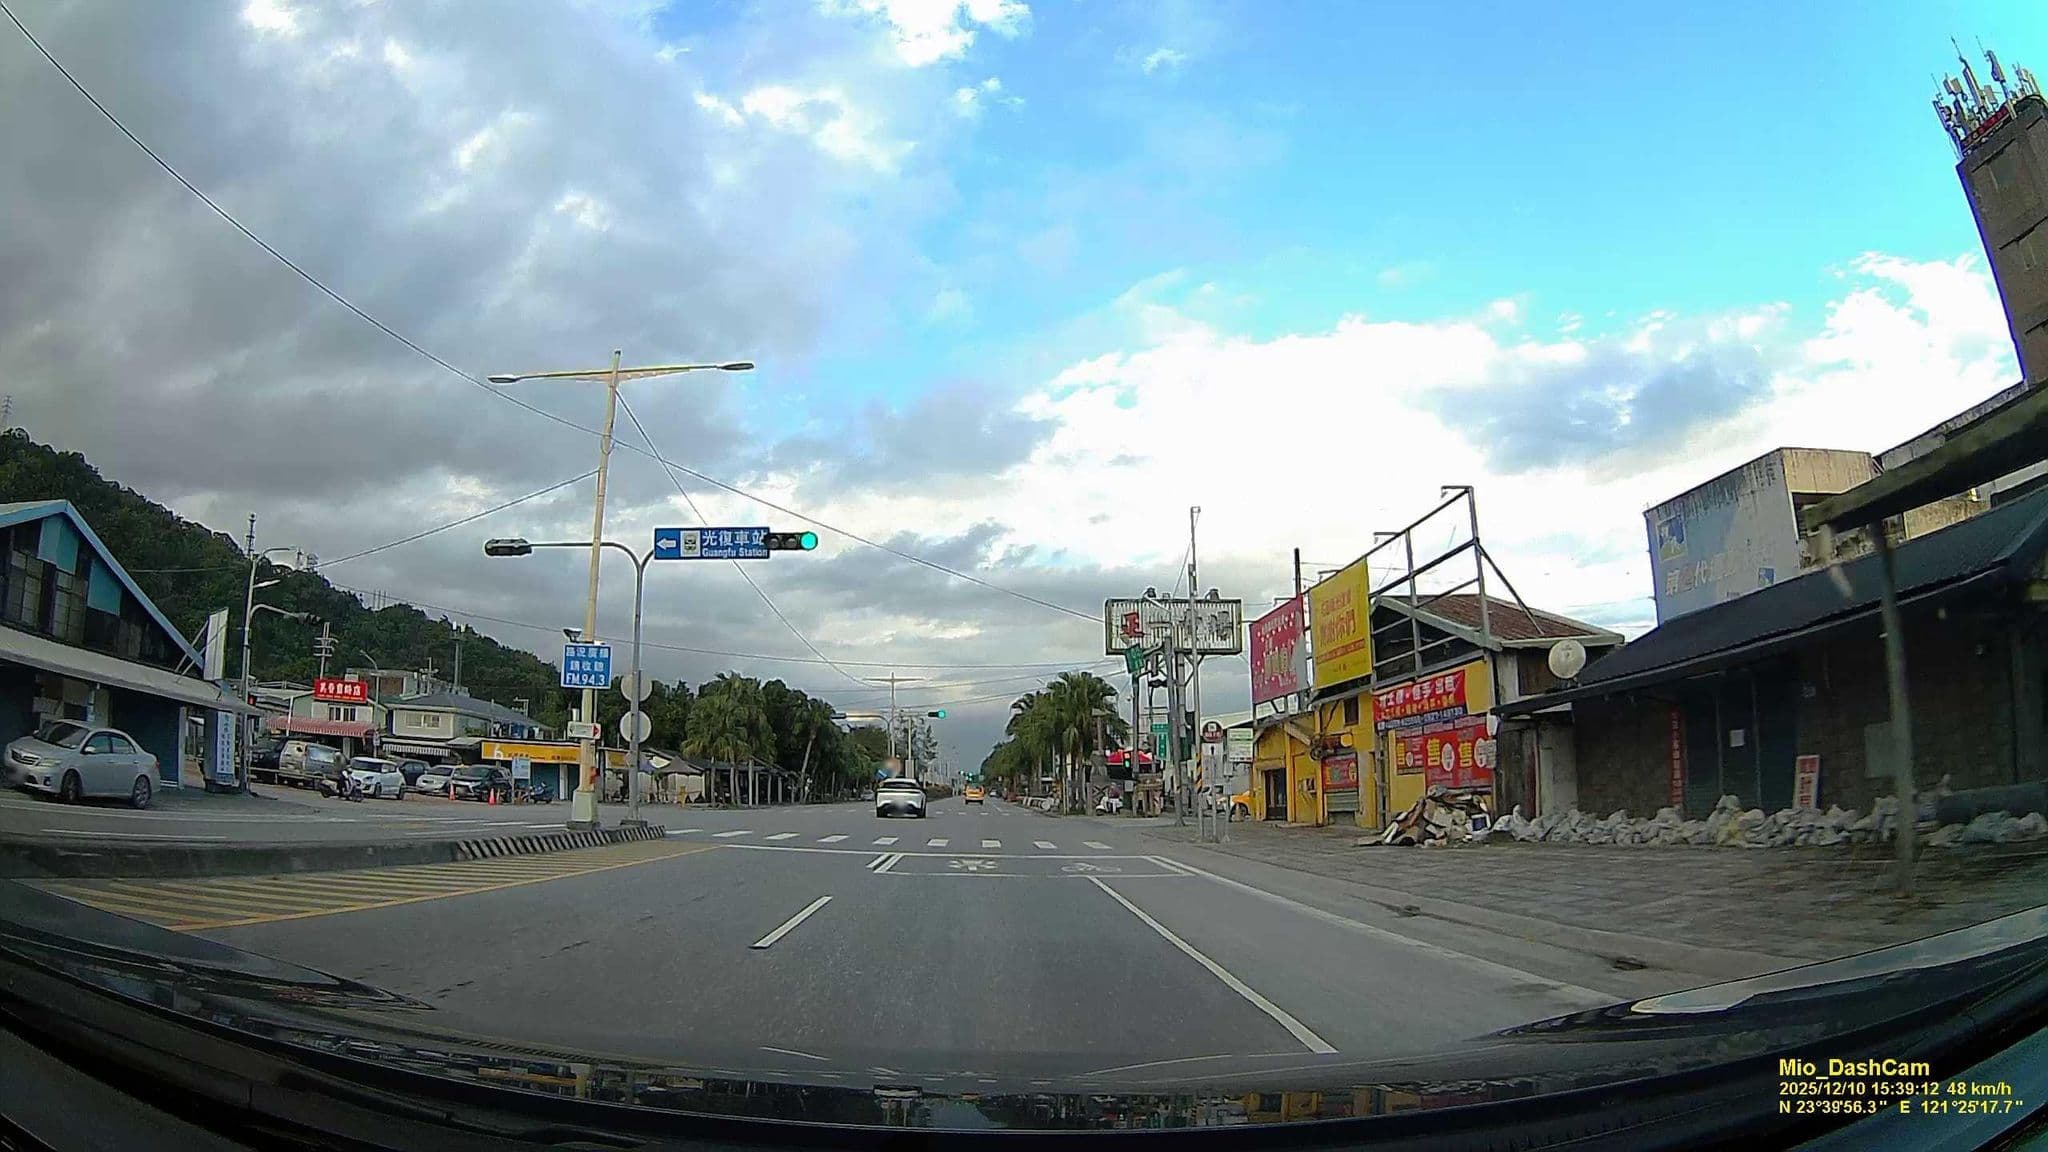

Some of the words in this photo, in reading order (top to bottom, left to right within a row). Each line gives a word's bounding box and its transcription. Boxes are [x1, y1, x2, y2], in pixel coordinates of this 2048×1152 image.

[702, 529, 767, 546] 光復車站
[702, 547, 737, 558] Guangfu
[739, 547, 768, 557] Station
[1427, 738, 1441, 766] 售
[1459, 742, 1473, 767] 售
